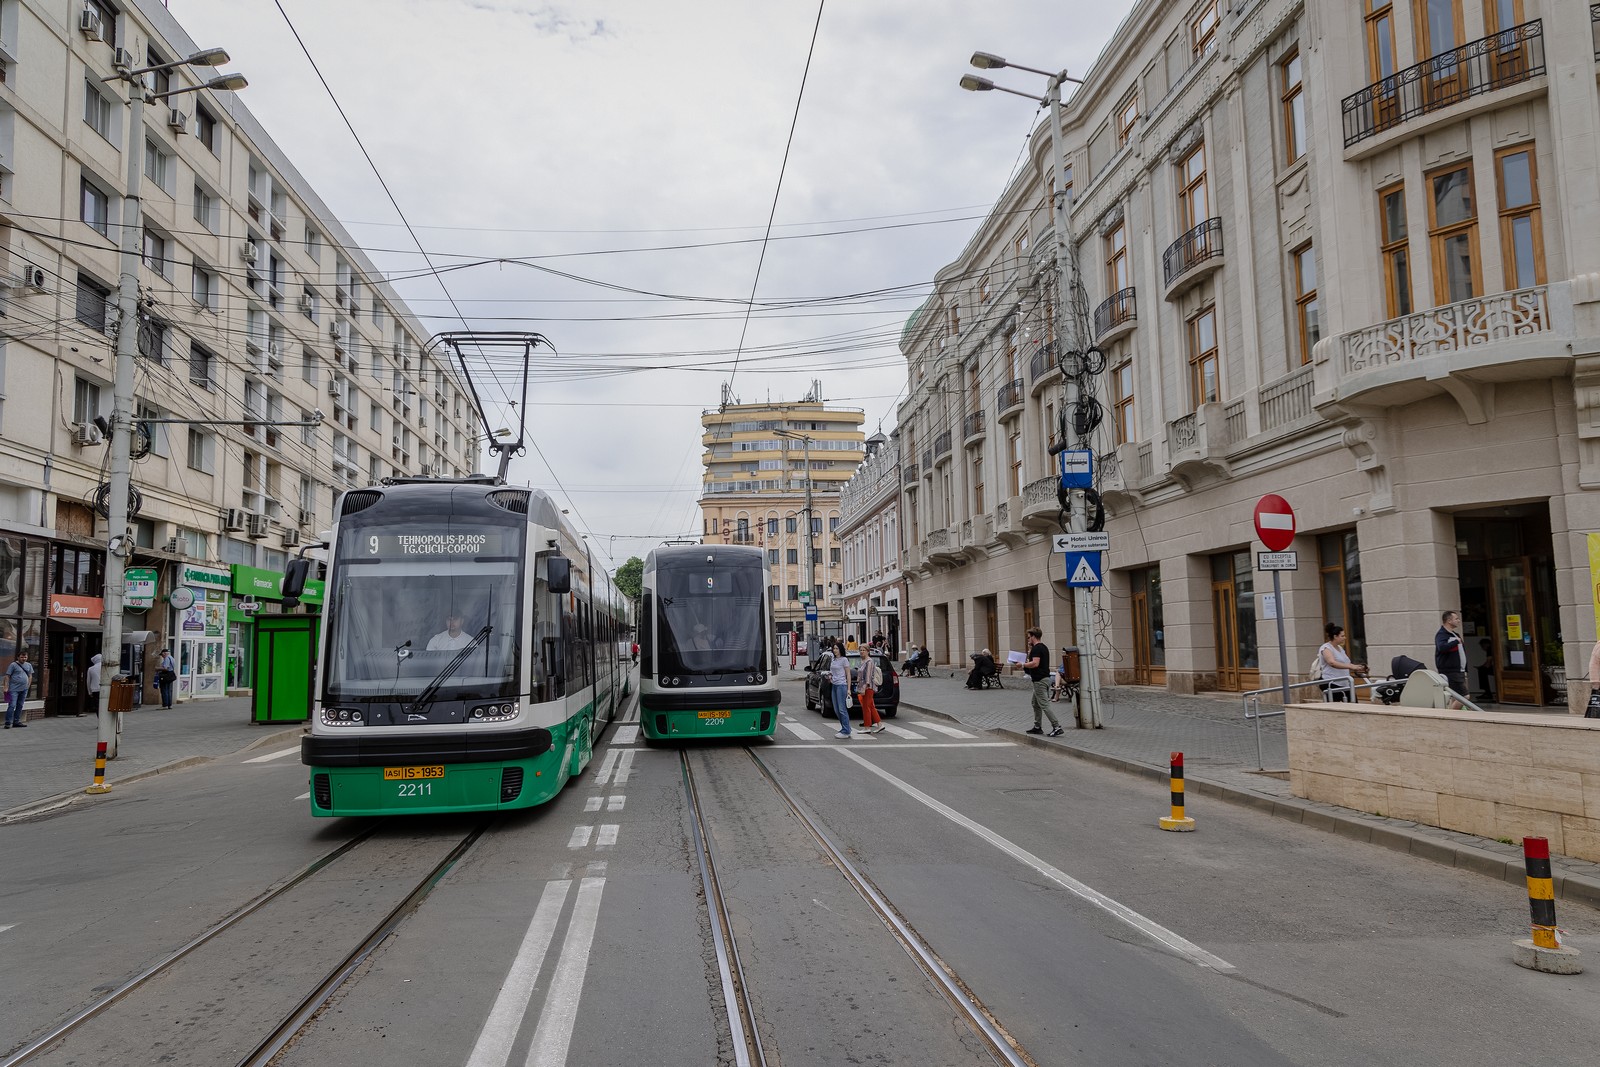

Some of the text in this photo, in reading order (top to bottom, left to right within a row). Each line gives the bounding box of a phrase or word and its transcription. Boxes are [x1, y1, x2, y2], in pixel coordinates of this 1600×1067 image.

[369, 535, 379, 554] 9
[402, 544, 480, 554] TG.CUCU-COPOU
[707, 577, 713, 588] 9
[60, 606, 88, 614] FORNETTI
[404, 766, 444, 778] IS-1953
[398, 783, 430, 796] 2211
